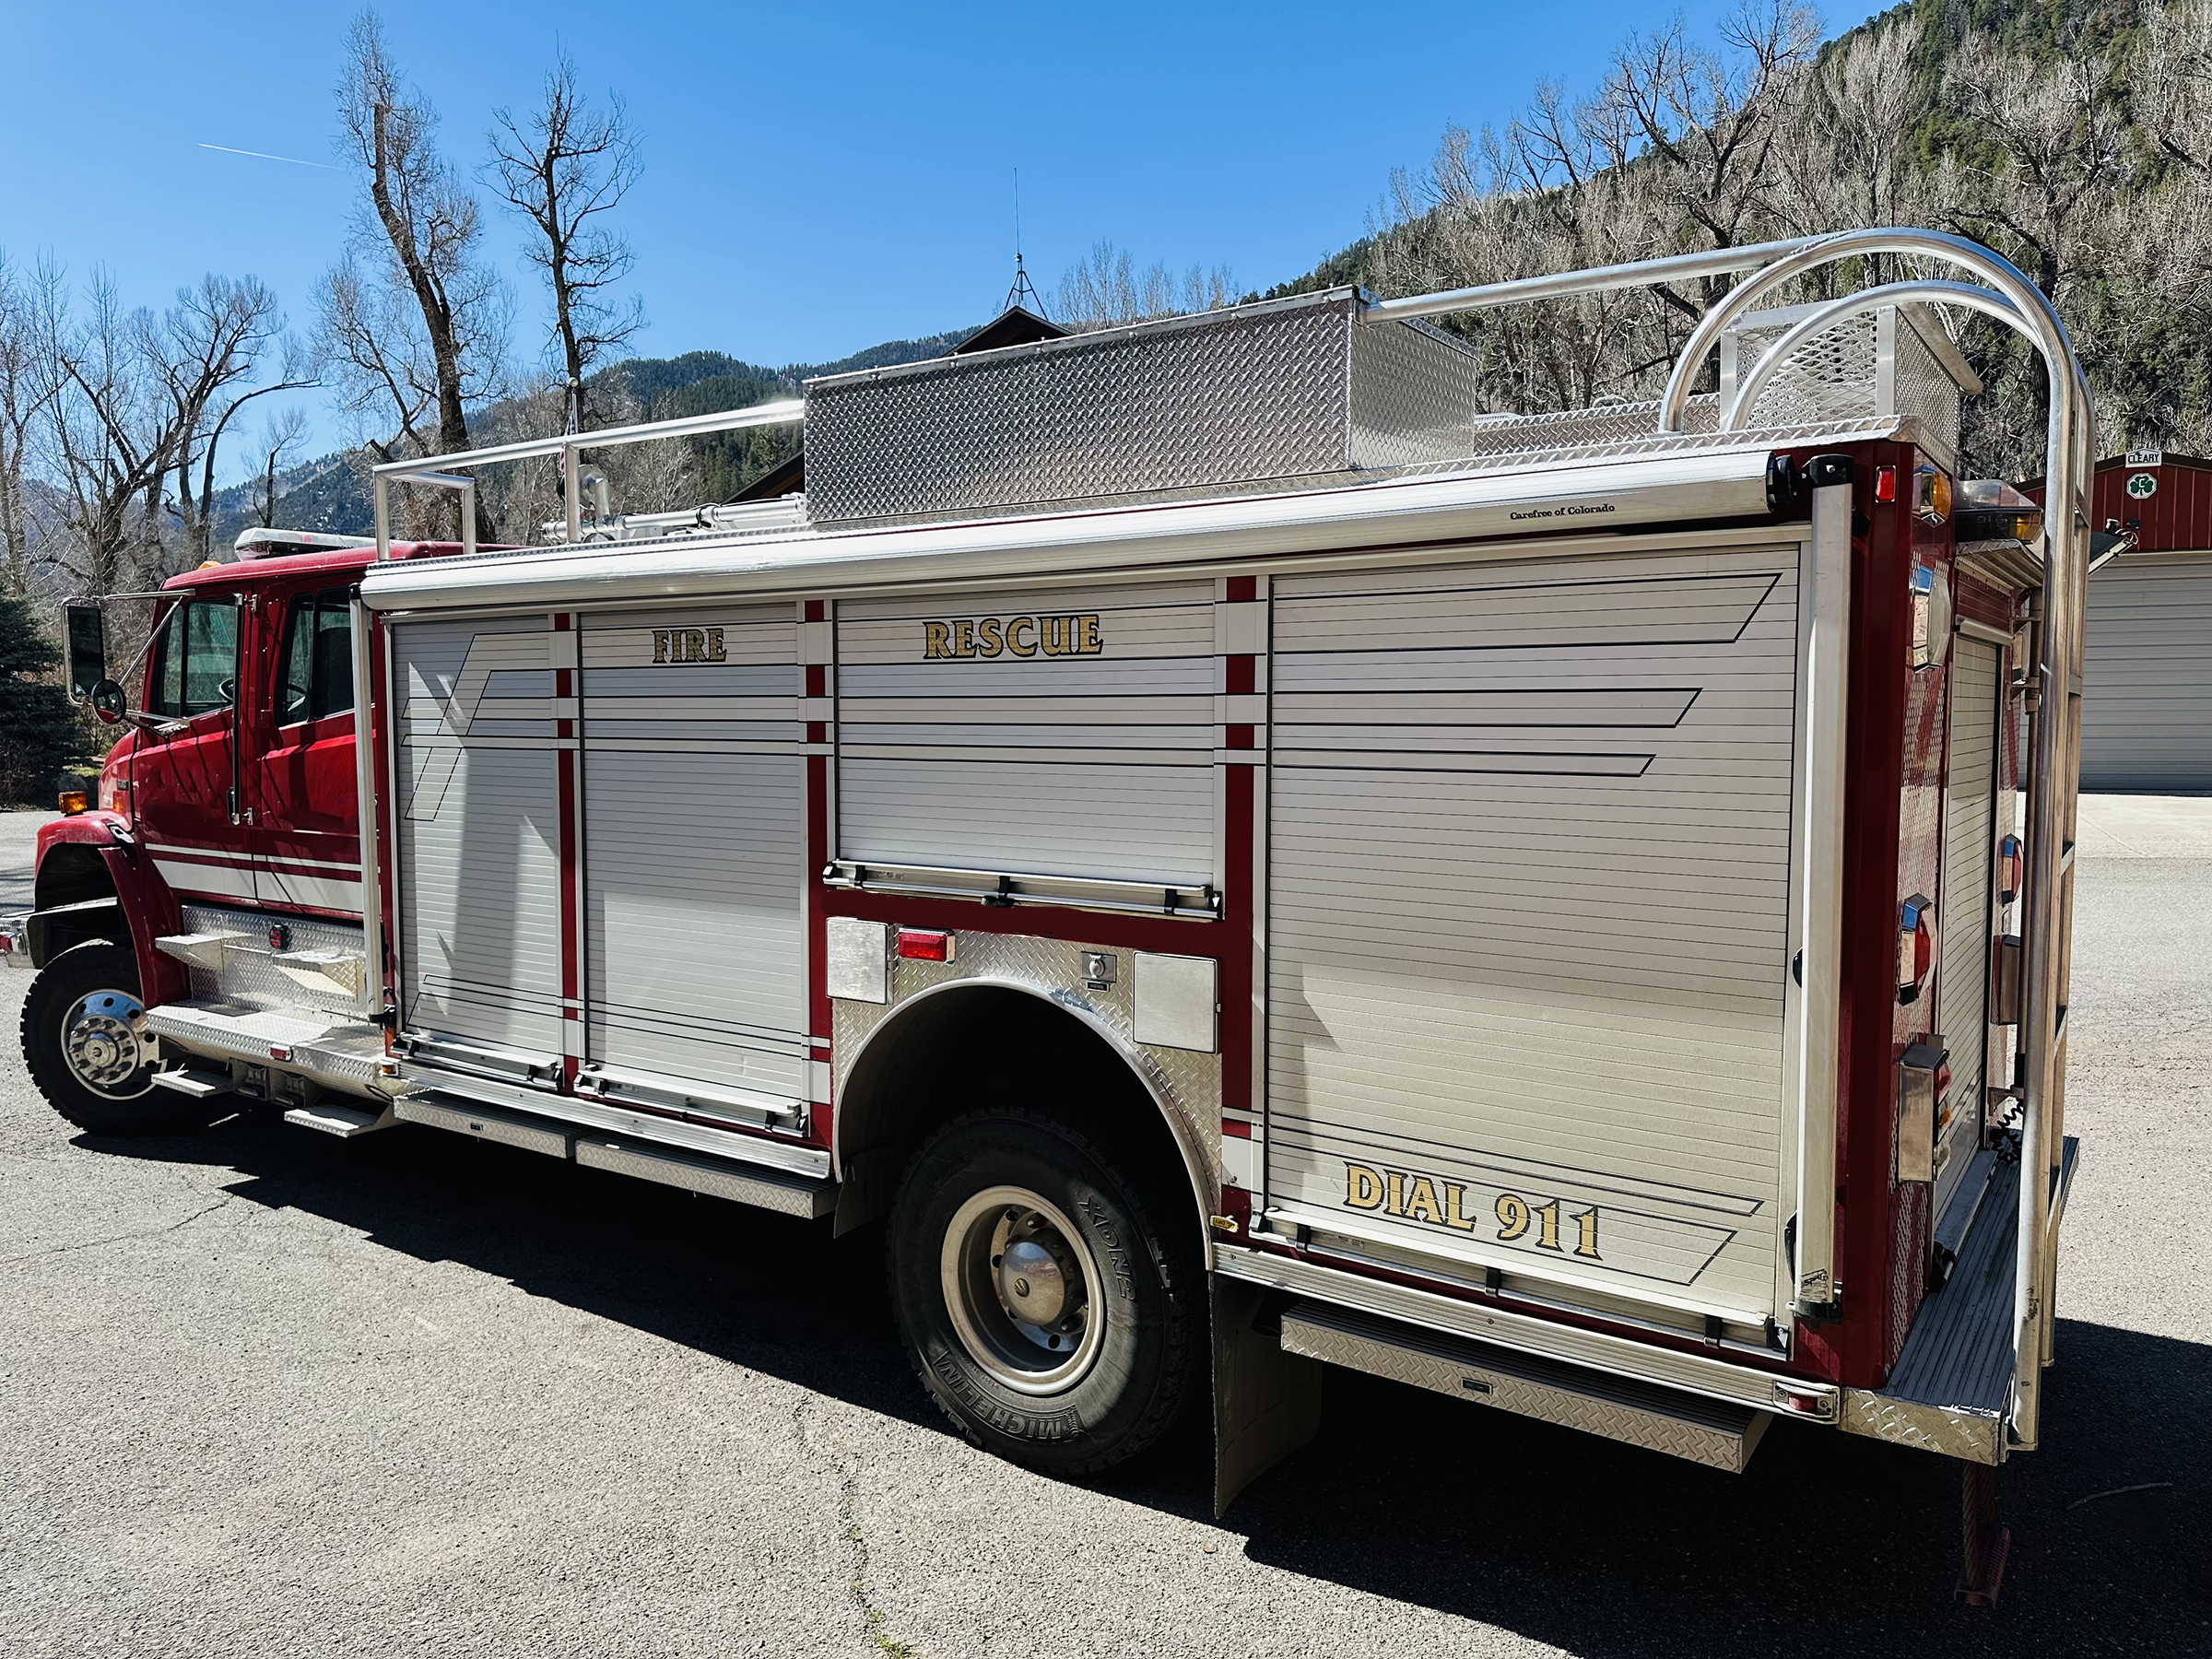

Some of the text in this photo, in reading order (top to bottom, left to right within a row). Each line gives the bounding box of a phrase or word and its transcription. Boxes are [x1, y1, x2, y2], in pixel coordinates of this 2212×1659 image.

[2128, 453, 2159, 464] CLEARY
[1510, 503, 1616, 520] Carefree of Colorado
[651, 614, 1104, 664] FIRE RESCUE
[1343, 1161, 1604, 1261] DIAL 911
[1077, 1194, 1135, 1300] XDN2
[938, 1359, 1061, 1440] MICHELIN
